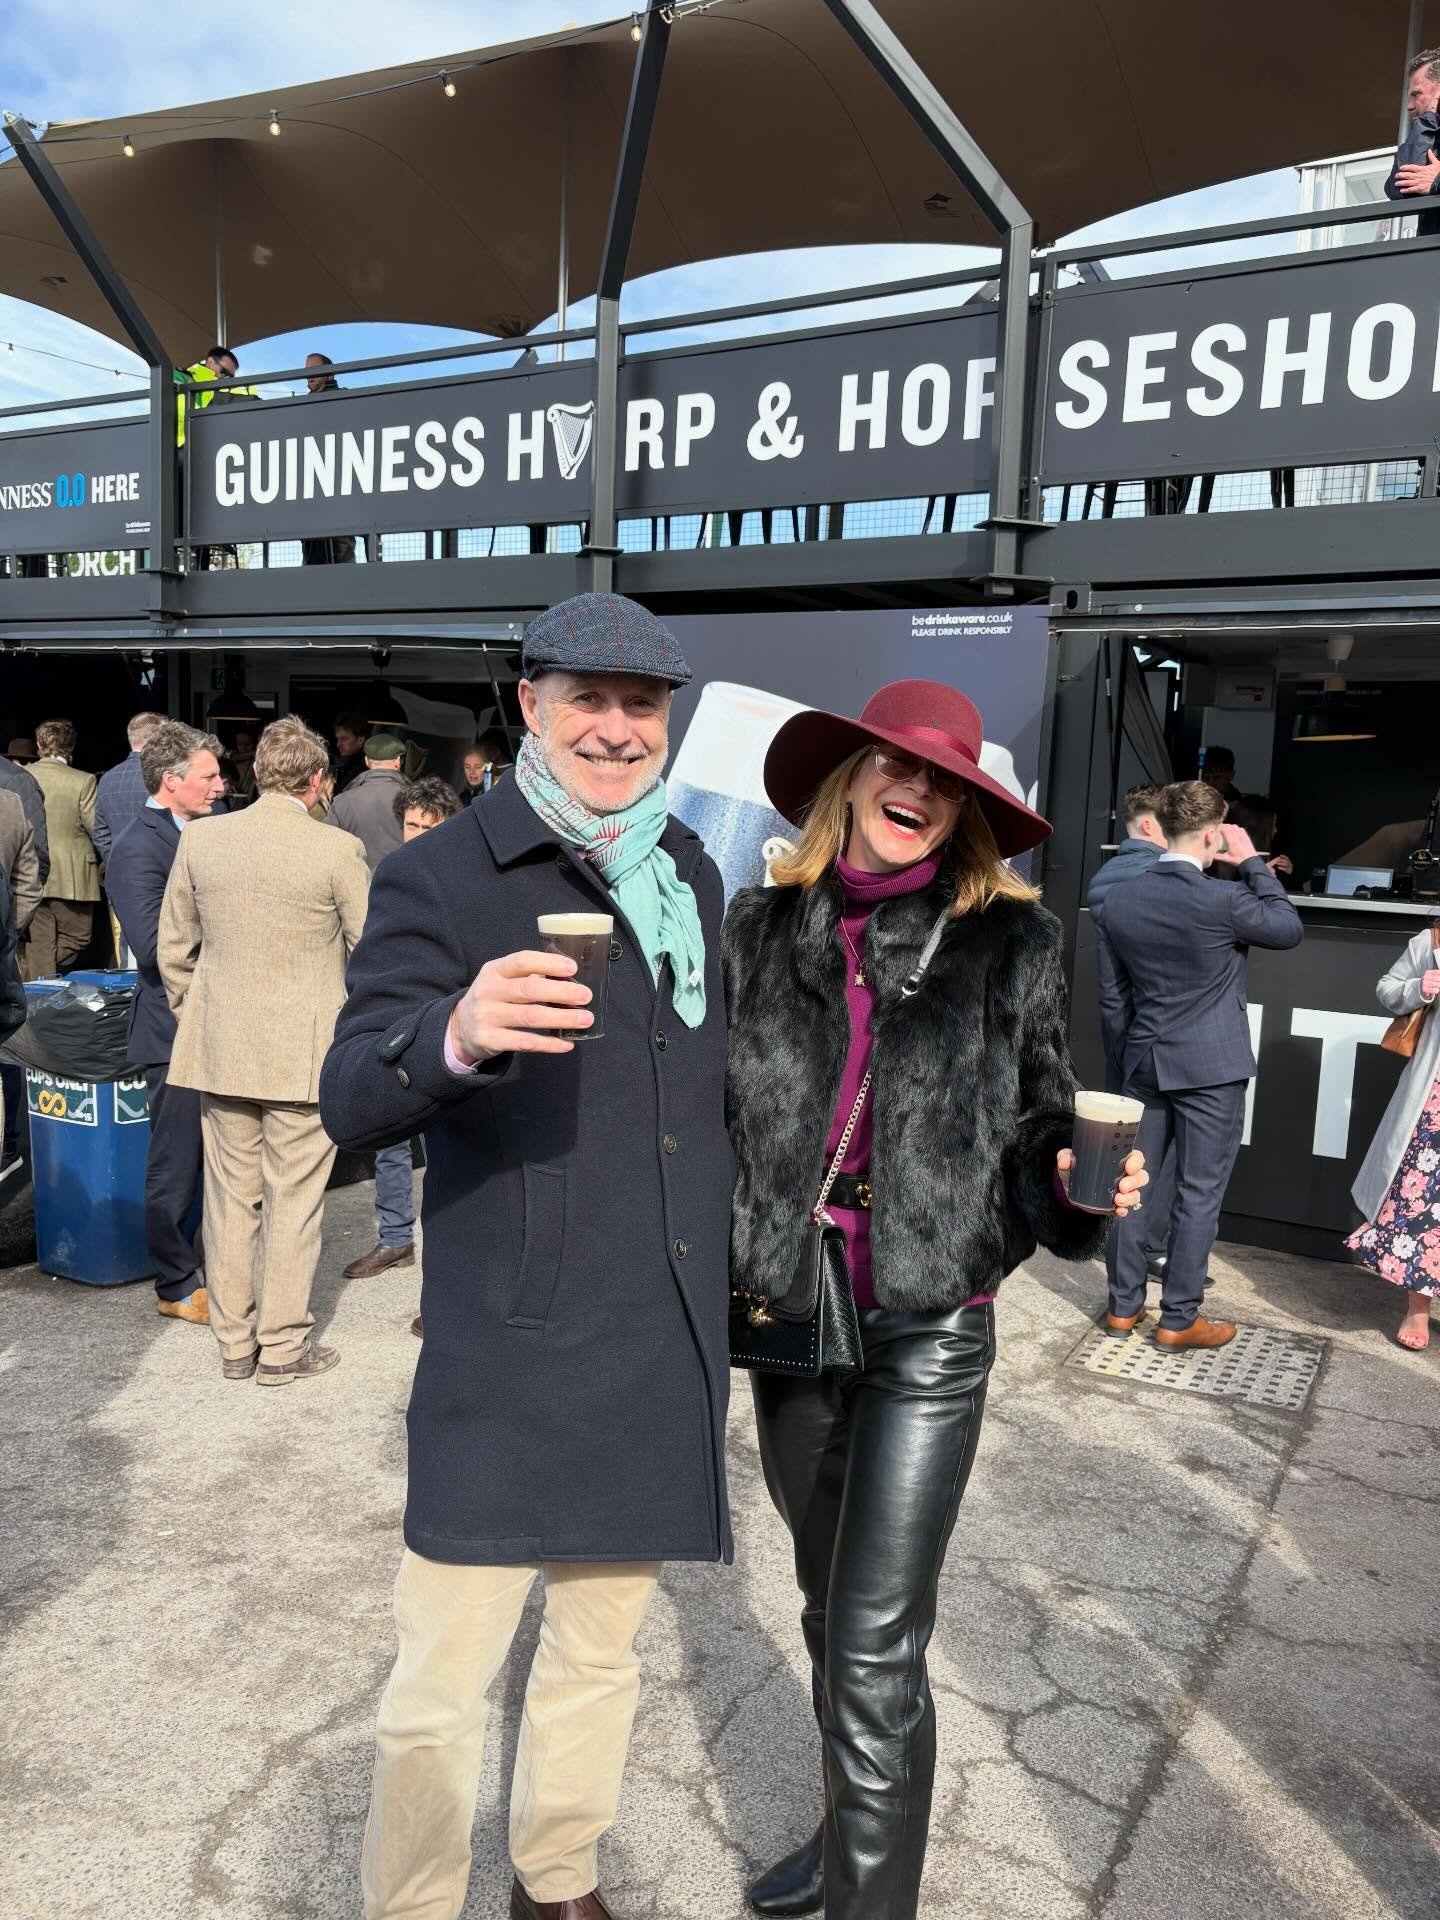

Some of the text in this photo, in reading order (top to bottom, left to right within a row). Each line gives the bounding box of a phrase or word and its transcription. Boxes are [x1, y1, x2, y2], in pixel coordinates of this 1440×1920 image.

[216, 417, 485, 507] GUINNESS
[747, 382, 805, 461] &
[56, 472, 86, 508] 0.0
[91, 472, 140, 504] HERE
[912, 612, 1013, 626] bedrinkaware.co.uk
[912, 628, 937, 637] PLEASE
[938, 627, 962, 637] DRINK
